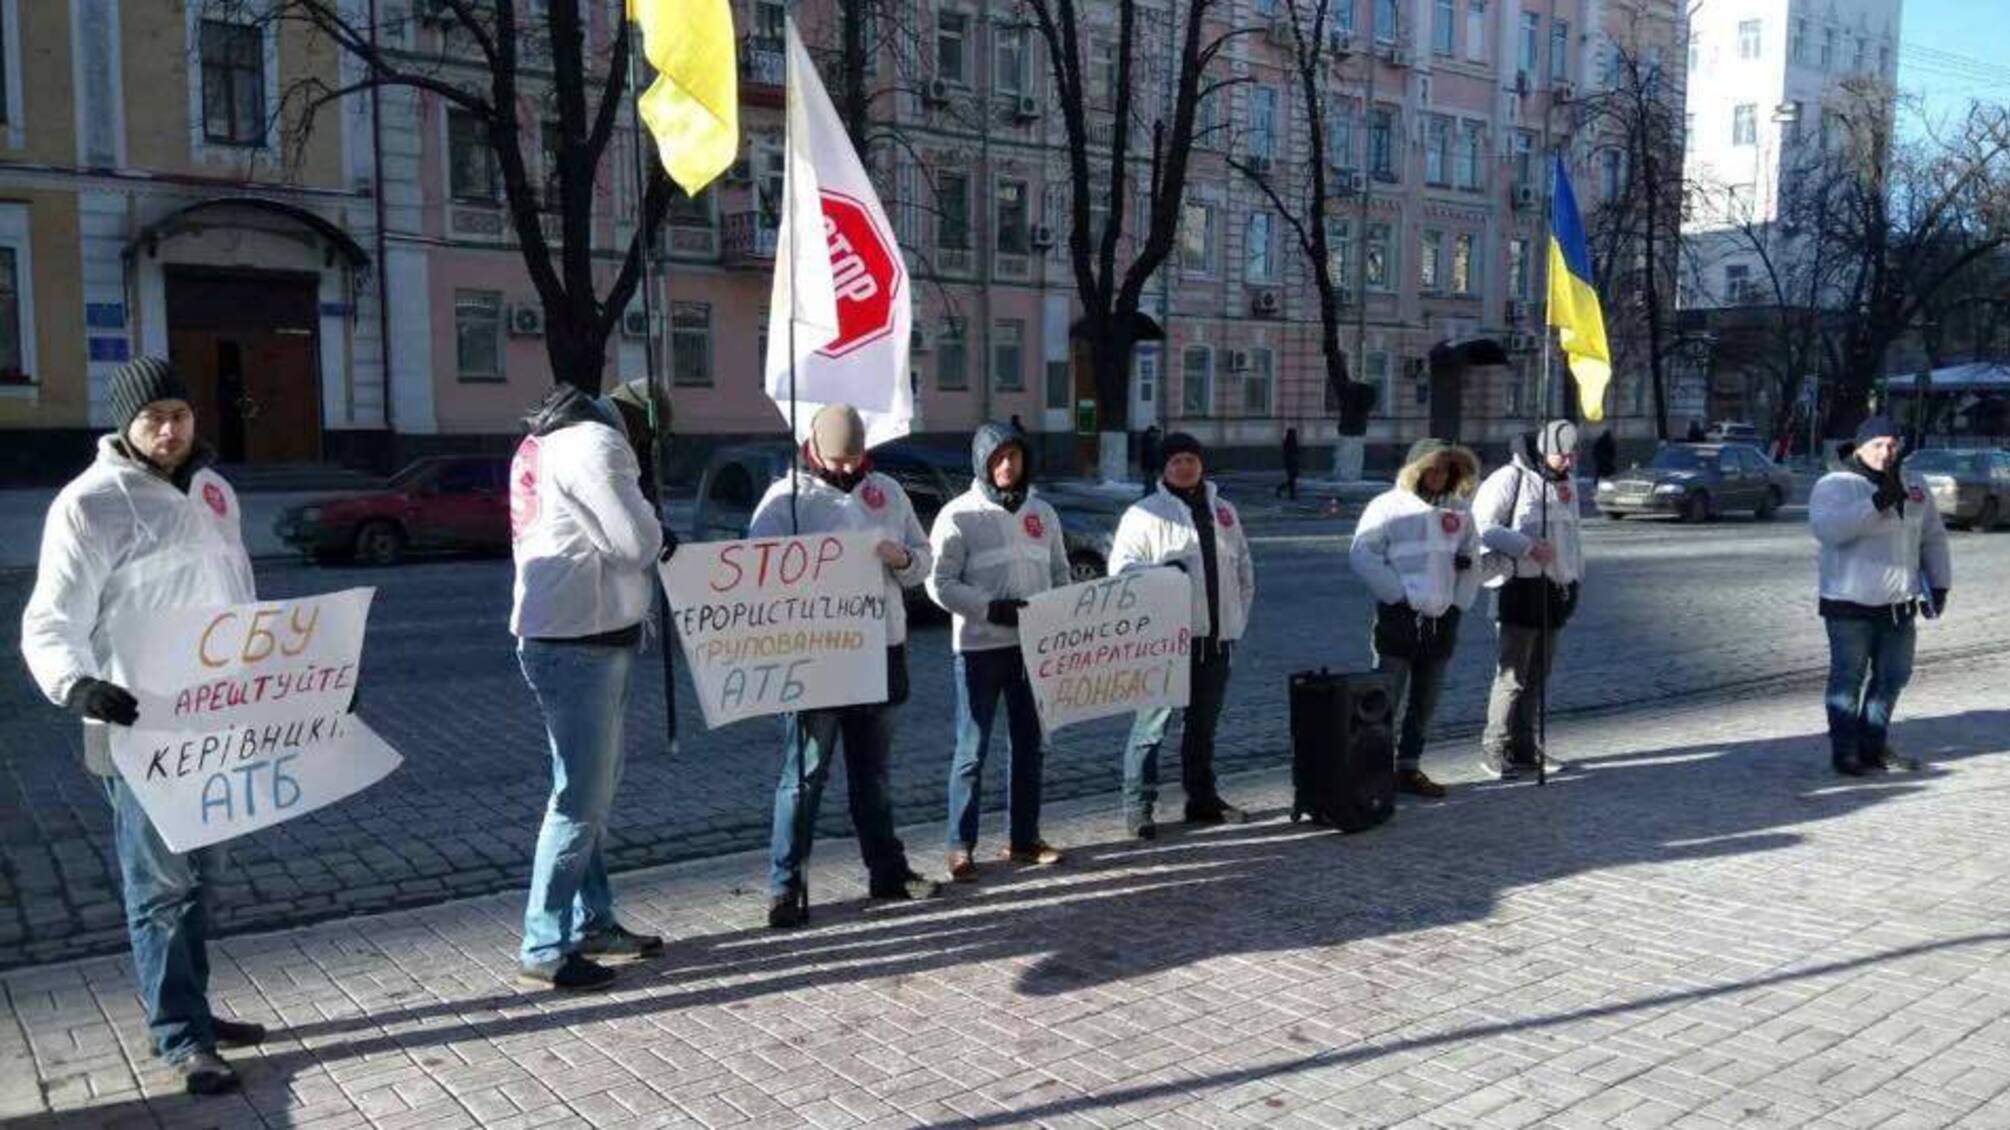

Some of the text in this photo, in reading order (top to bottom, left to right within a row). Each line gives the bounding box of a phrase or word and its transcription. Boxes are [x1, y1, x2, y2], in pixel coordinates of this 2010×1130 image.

[710, 537, 843, 592] STOP
[1074, 573, 1143, 617] АТБ
[199, 605, 320, 668] СБУ
[1037, 616, 1150, 655] СПОНСОР
[174, 664, 354, 716] АРЕШТУЙТЕ
[720, 658, 815, 713] АТБ
[201, 754, 302, 825] АТБ
